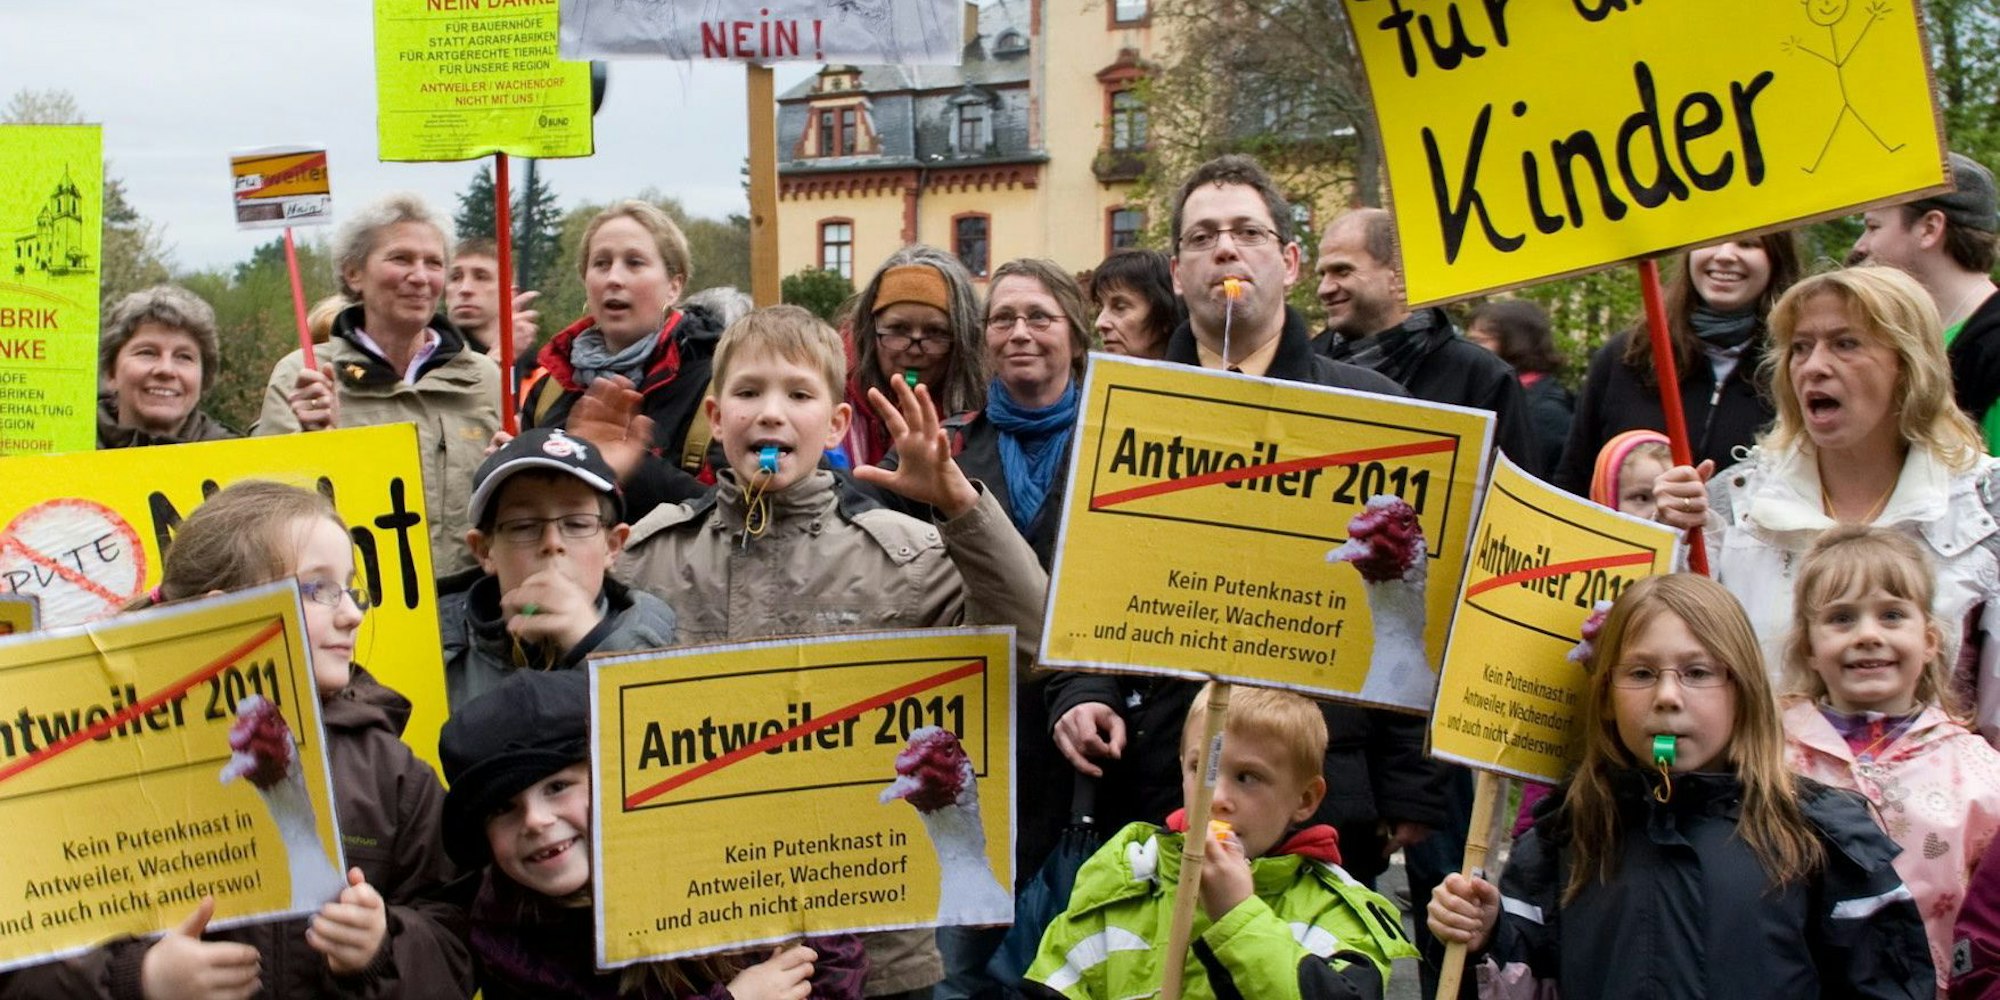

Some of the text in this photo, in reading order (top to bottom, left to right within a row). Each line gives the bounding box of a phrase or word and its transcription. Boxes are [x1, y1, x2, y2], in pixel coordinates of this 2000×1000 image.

[429, 32, 556, 48] STATT AGRARFABRIKEN
[445, 18, 543, 33] FÜR BAUERNHÖFE
[701, 8, 798, 59] NEIN
[400, 50, 423, 61] FÜR
[428, 48, 509, 60] ARTGERECHTE
[439, 61, 550, 74] FÜR UNSERE REGION
[420, 82, 486, 92] ANTWEILER
[495, 77, 565, 89] WACHENDORF
[455, 95, 487, 106] NICHT
[491, 95, 509, 105] MIT
[512, 93, 533, 104] UNS
[548, 117, 569, 127] BUND
[1422, 60, 1774, 265] Kinder
[0, 371, 27, 384] ÖFE
[1109, 427, 1430, 515] Antweiler 2011
[2, 532, 120, 594] PUTE
[1477, 523, 1635, 609] Antweiler 201
[1168, 569, 1346, 611] Kein Putenknast in
[1126, 595, 1344, 638] Antweiler, Wachendorf
[1094, 621, 1126, 641] und
[1131, 625, 1174, 646] auch
[1180, 629, 1227, 652] nicht
[1233, 636, 1336, 667] anderswo!
[200, 656, 283, 721] 2011
[1483, 663, 1503, 686] Kein
[1505, 670, 1564, 702] Putenknast
[1447, 714, 1461, 731] und
[1461, 719, 1481, 737] auch
[1483, 722, 1508, 745] nicht
[1463, 686, 1574, 732] Antweiler, Wachendorf
[638, 694, 965, 771] Antweiler 2011
[62, 810, 253, 861] Kein Putenknast in
[725, 829, 907, 863] Kein Putenknast in
[24, 836, 259, 899] Antweiler, Wachendorf
[687, 856, 907, 898] Antweiler, Wachendorf
[41, 900, 92, 928] auch
[99, 889, 152, 918] nicht
[157, 870, 261, 906] anderswo!
[656, 911, 691, 932] und
[698, 903, 743, 925] auch
[749, 895, 798, 917] nicht
[803, 884, 906, 911] anderswo!
